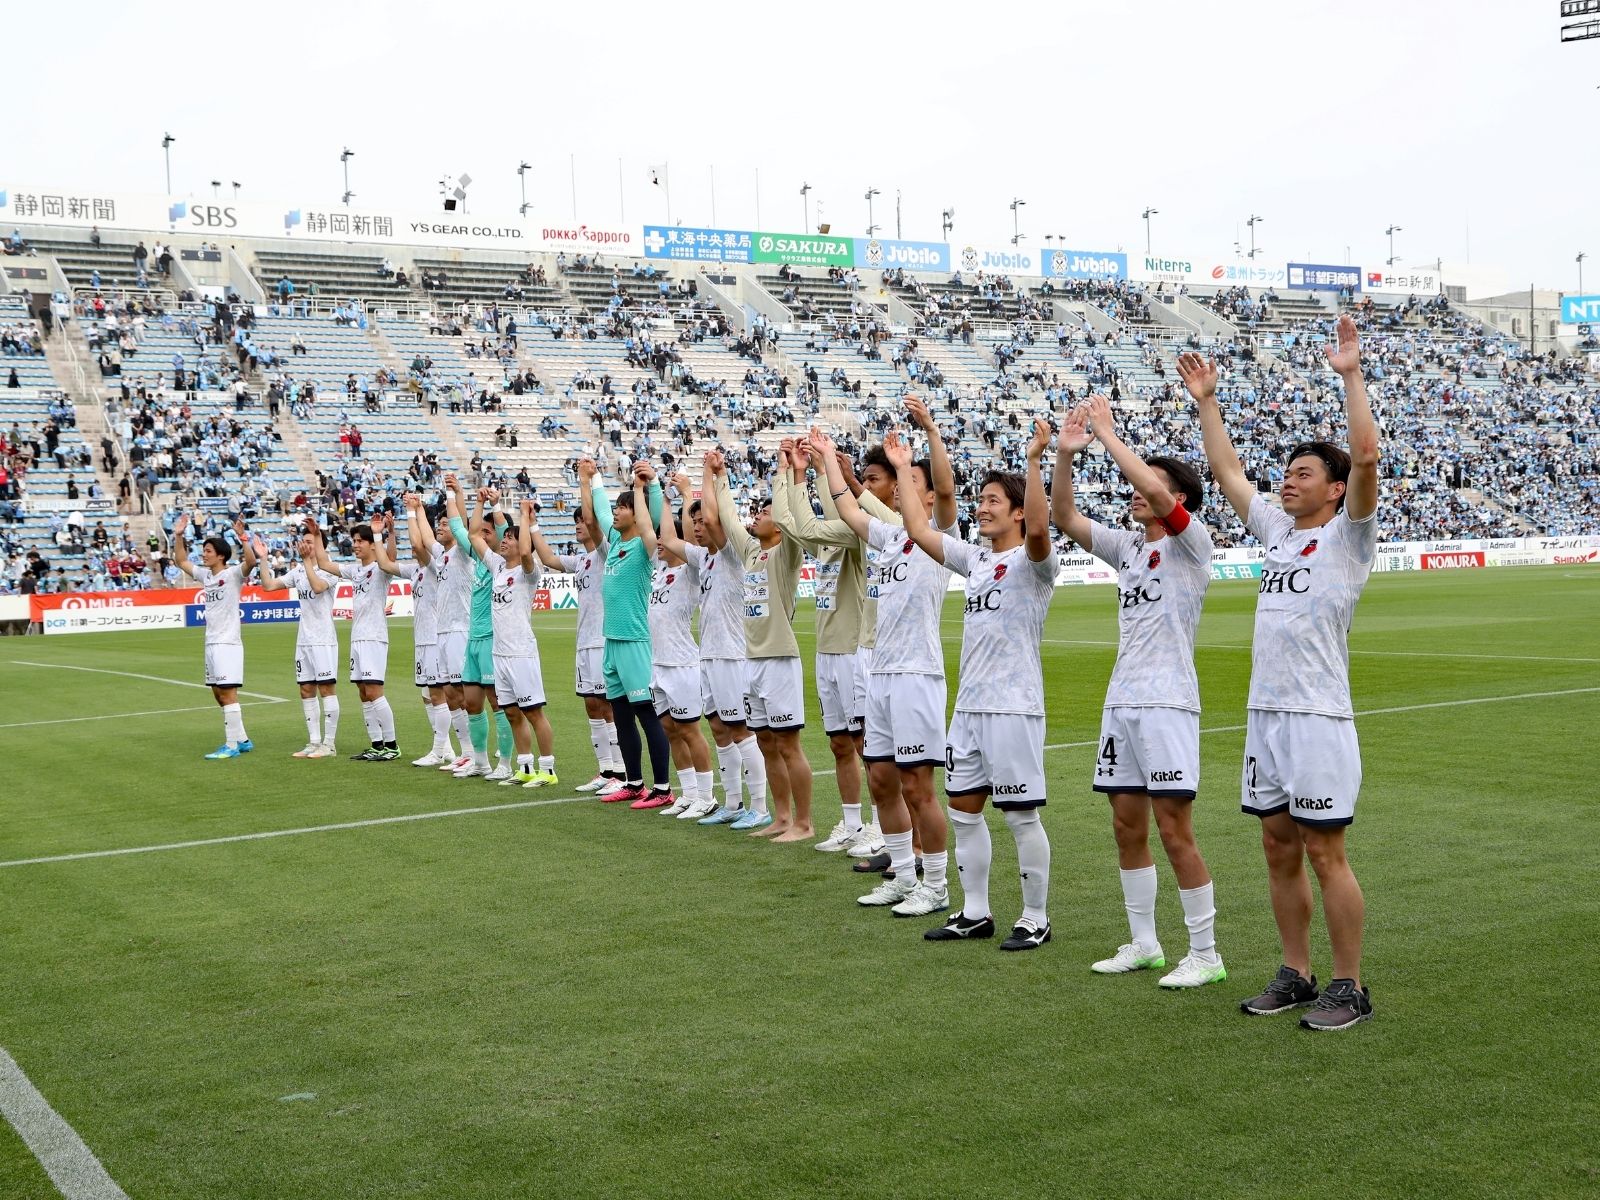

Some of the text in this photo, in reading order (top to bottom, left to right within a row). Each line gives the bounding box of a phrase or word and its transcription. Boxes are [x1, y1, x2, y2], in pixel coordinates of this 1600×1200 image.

[14, 193, 115, 221] 静岡新聞
[191, 205, 238, 228] SBS
[306, 211, 393, 237] 静岡新聞
[410, 222, 429, 233] Y'S
[432, 224, 468, 235] GEAR
[666, 230, 752, 248] 東海中央薬局
[775, 239, 848, 256] SAKURA
[1145, 257, 1192, 273] Niterra
[1226, 265, 1285, 281] 遠州トラック
[1385, 274, 1434, 290] 中日新聞
[1378, 545, 1406, 554] Admiral
[1434, 543, 1462, 552] Admiral
[1490, 541, 1516, 550] Admiral
[1060, 557, 1094, 566] Admiral
[1427, 554, 1478, 569] NOMURA
